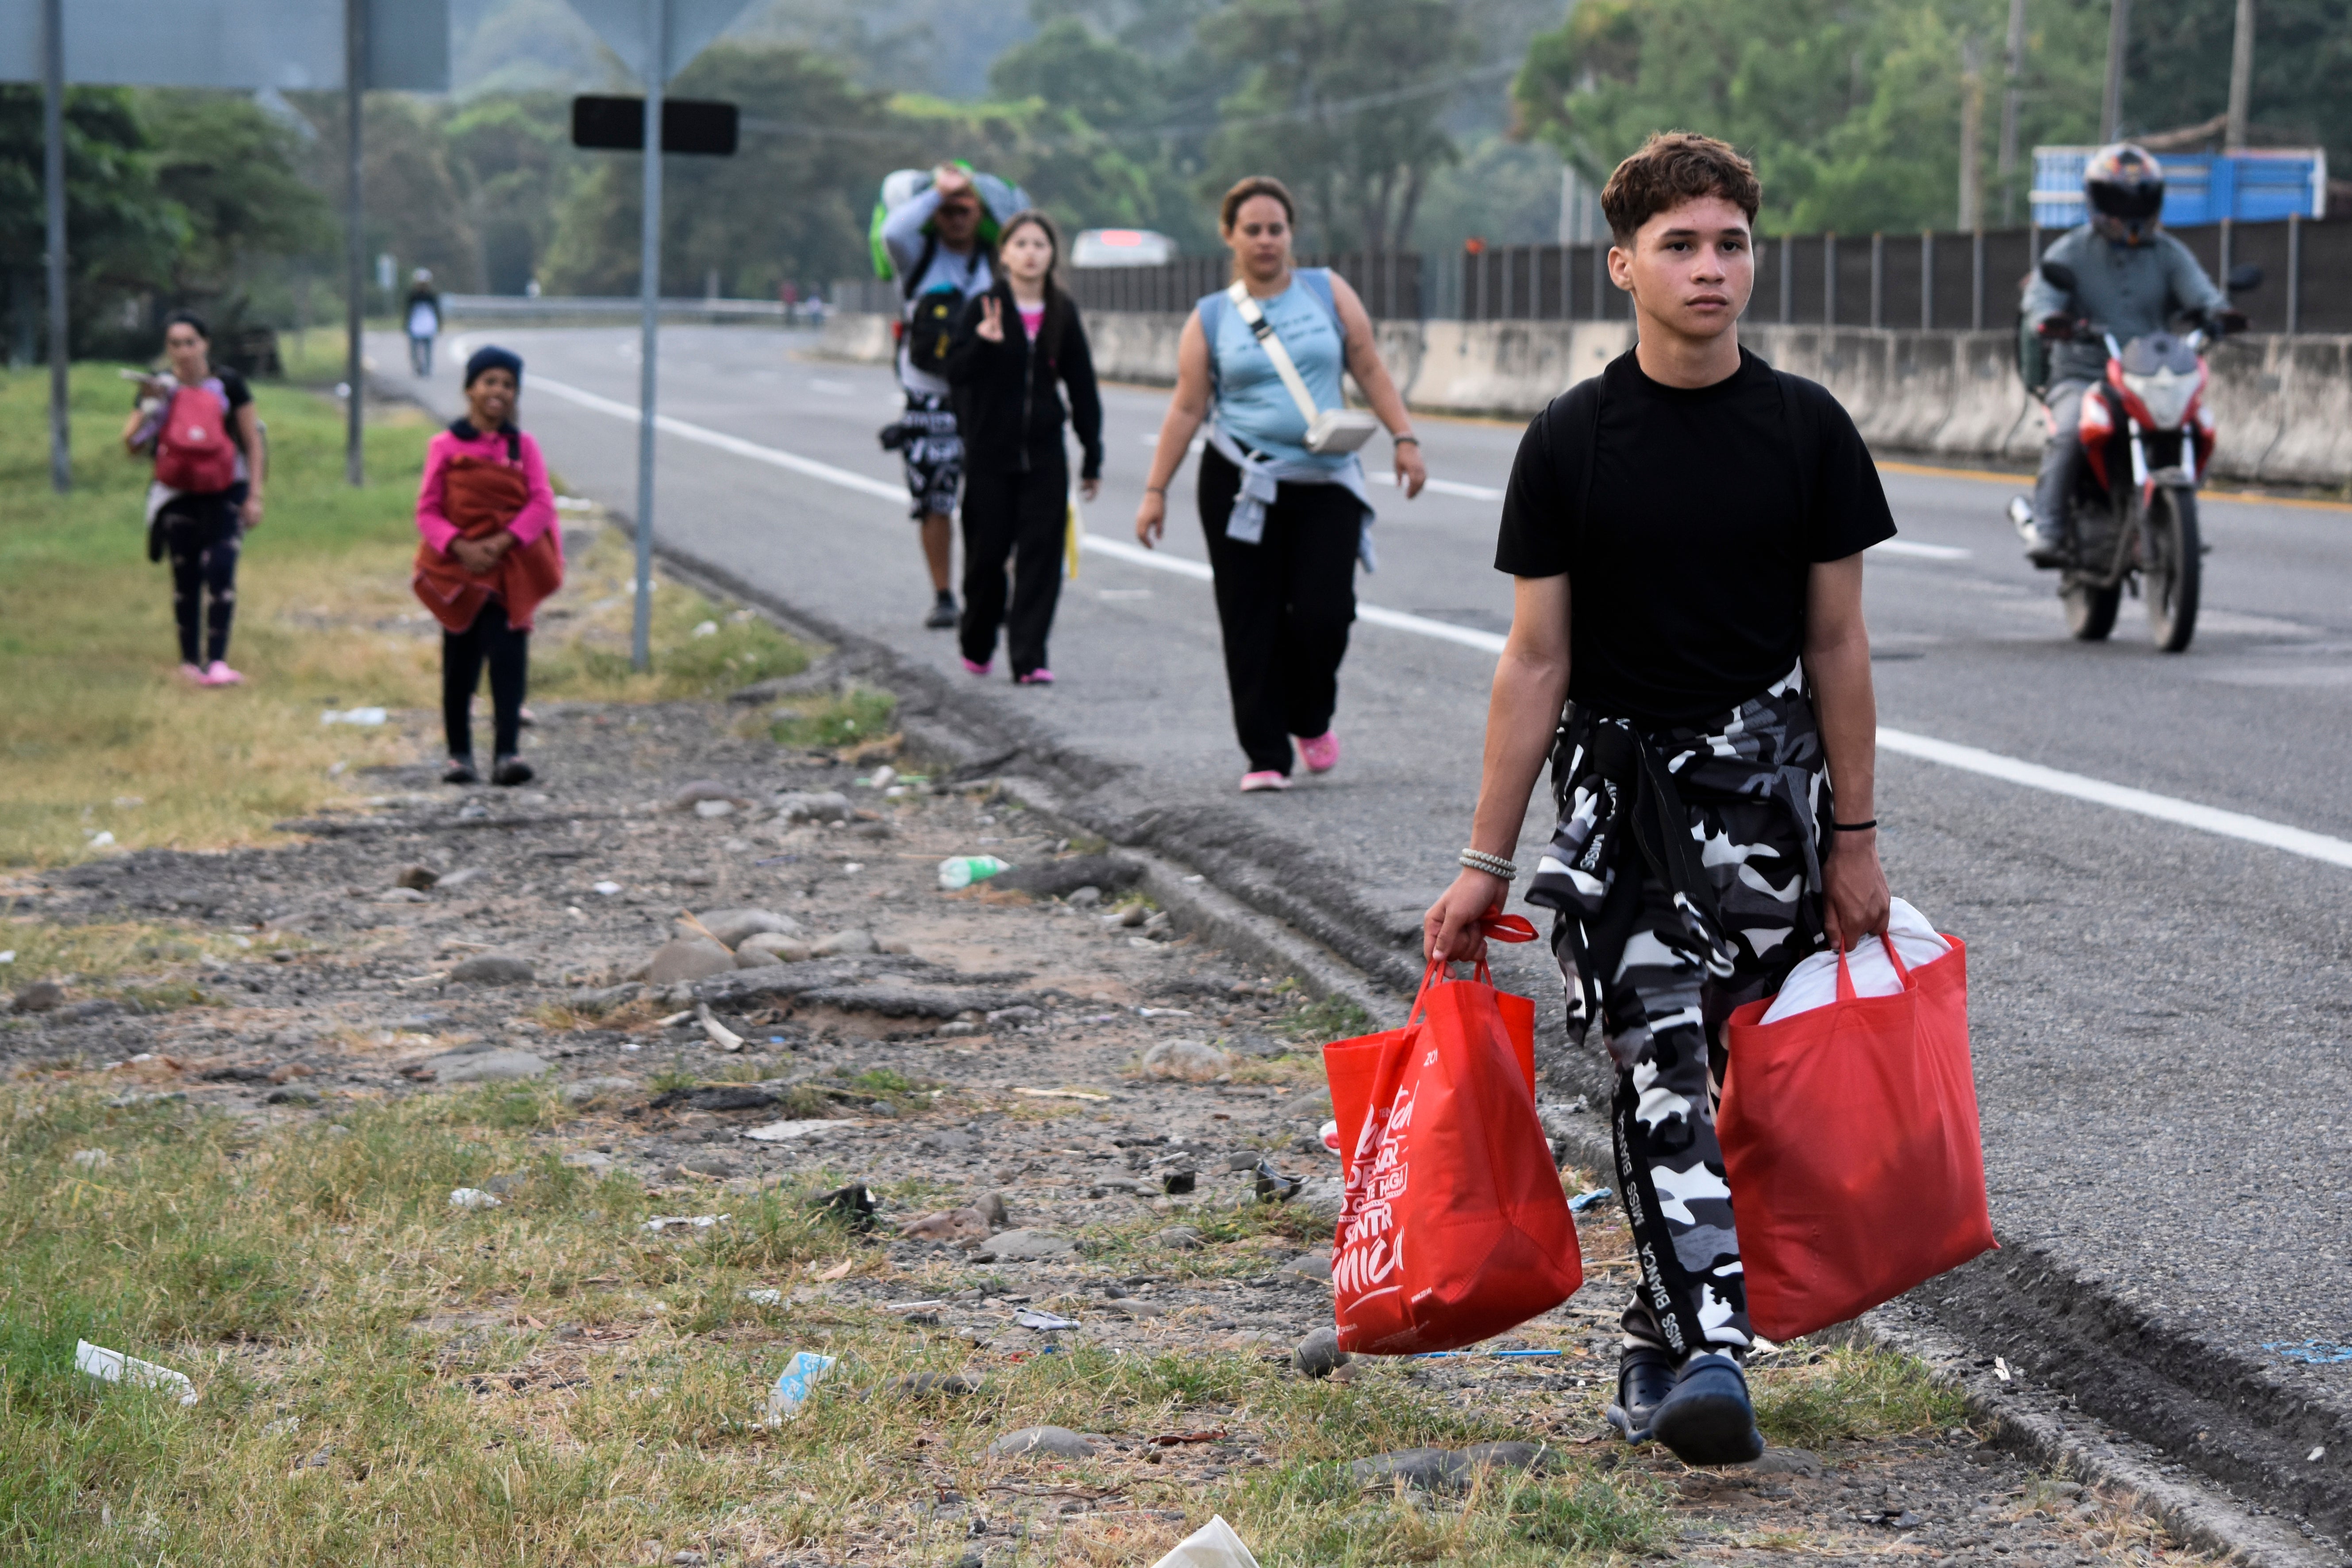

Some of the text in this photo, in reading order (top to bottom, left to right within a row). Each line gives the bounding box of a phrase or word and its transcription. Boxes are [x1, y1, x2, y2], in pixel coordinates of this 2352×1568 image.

[1617, 1110, 1633, 1177] BIANCA
[1627, 1181, 1646, 1227] MISS
[1641, 1241, 1687, 1355] MISS BIANCA
